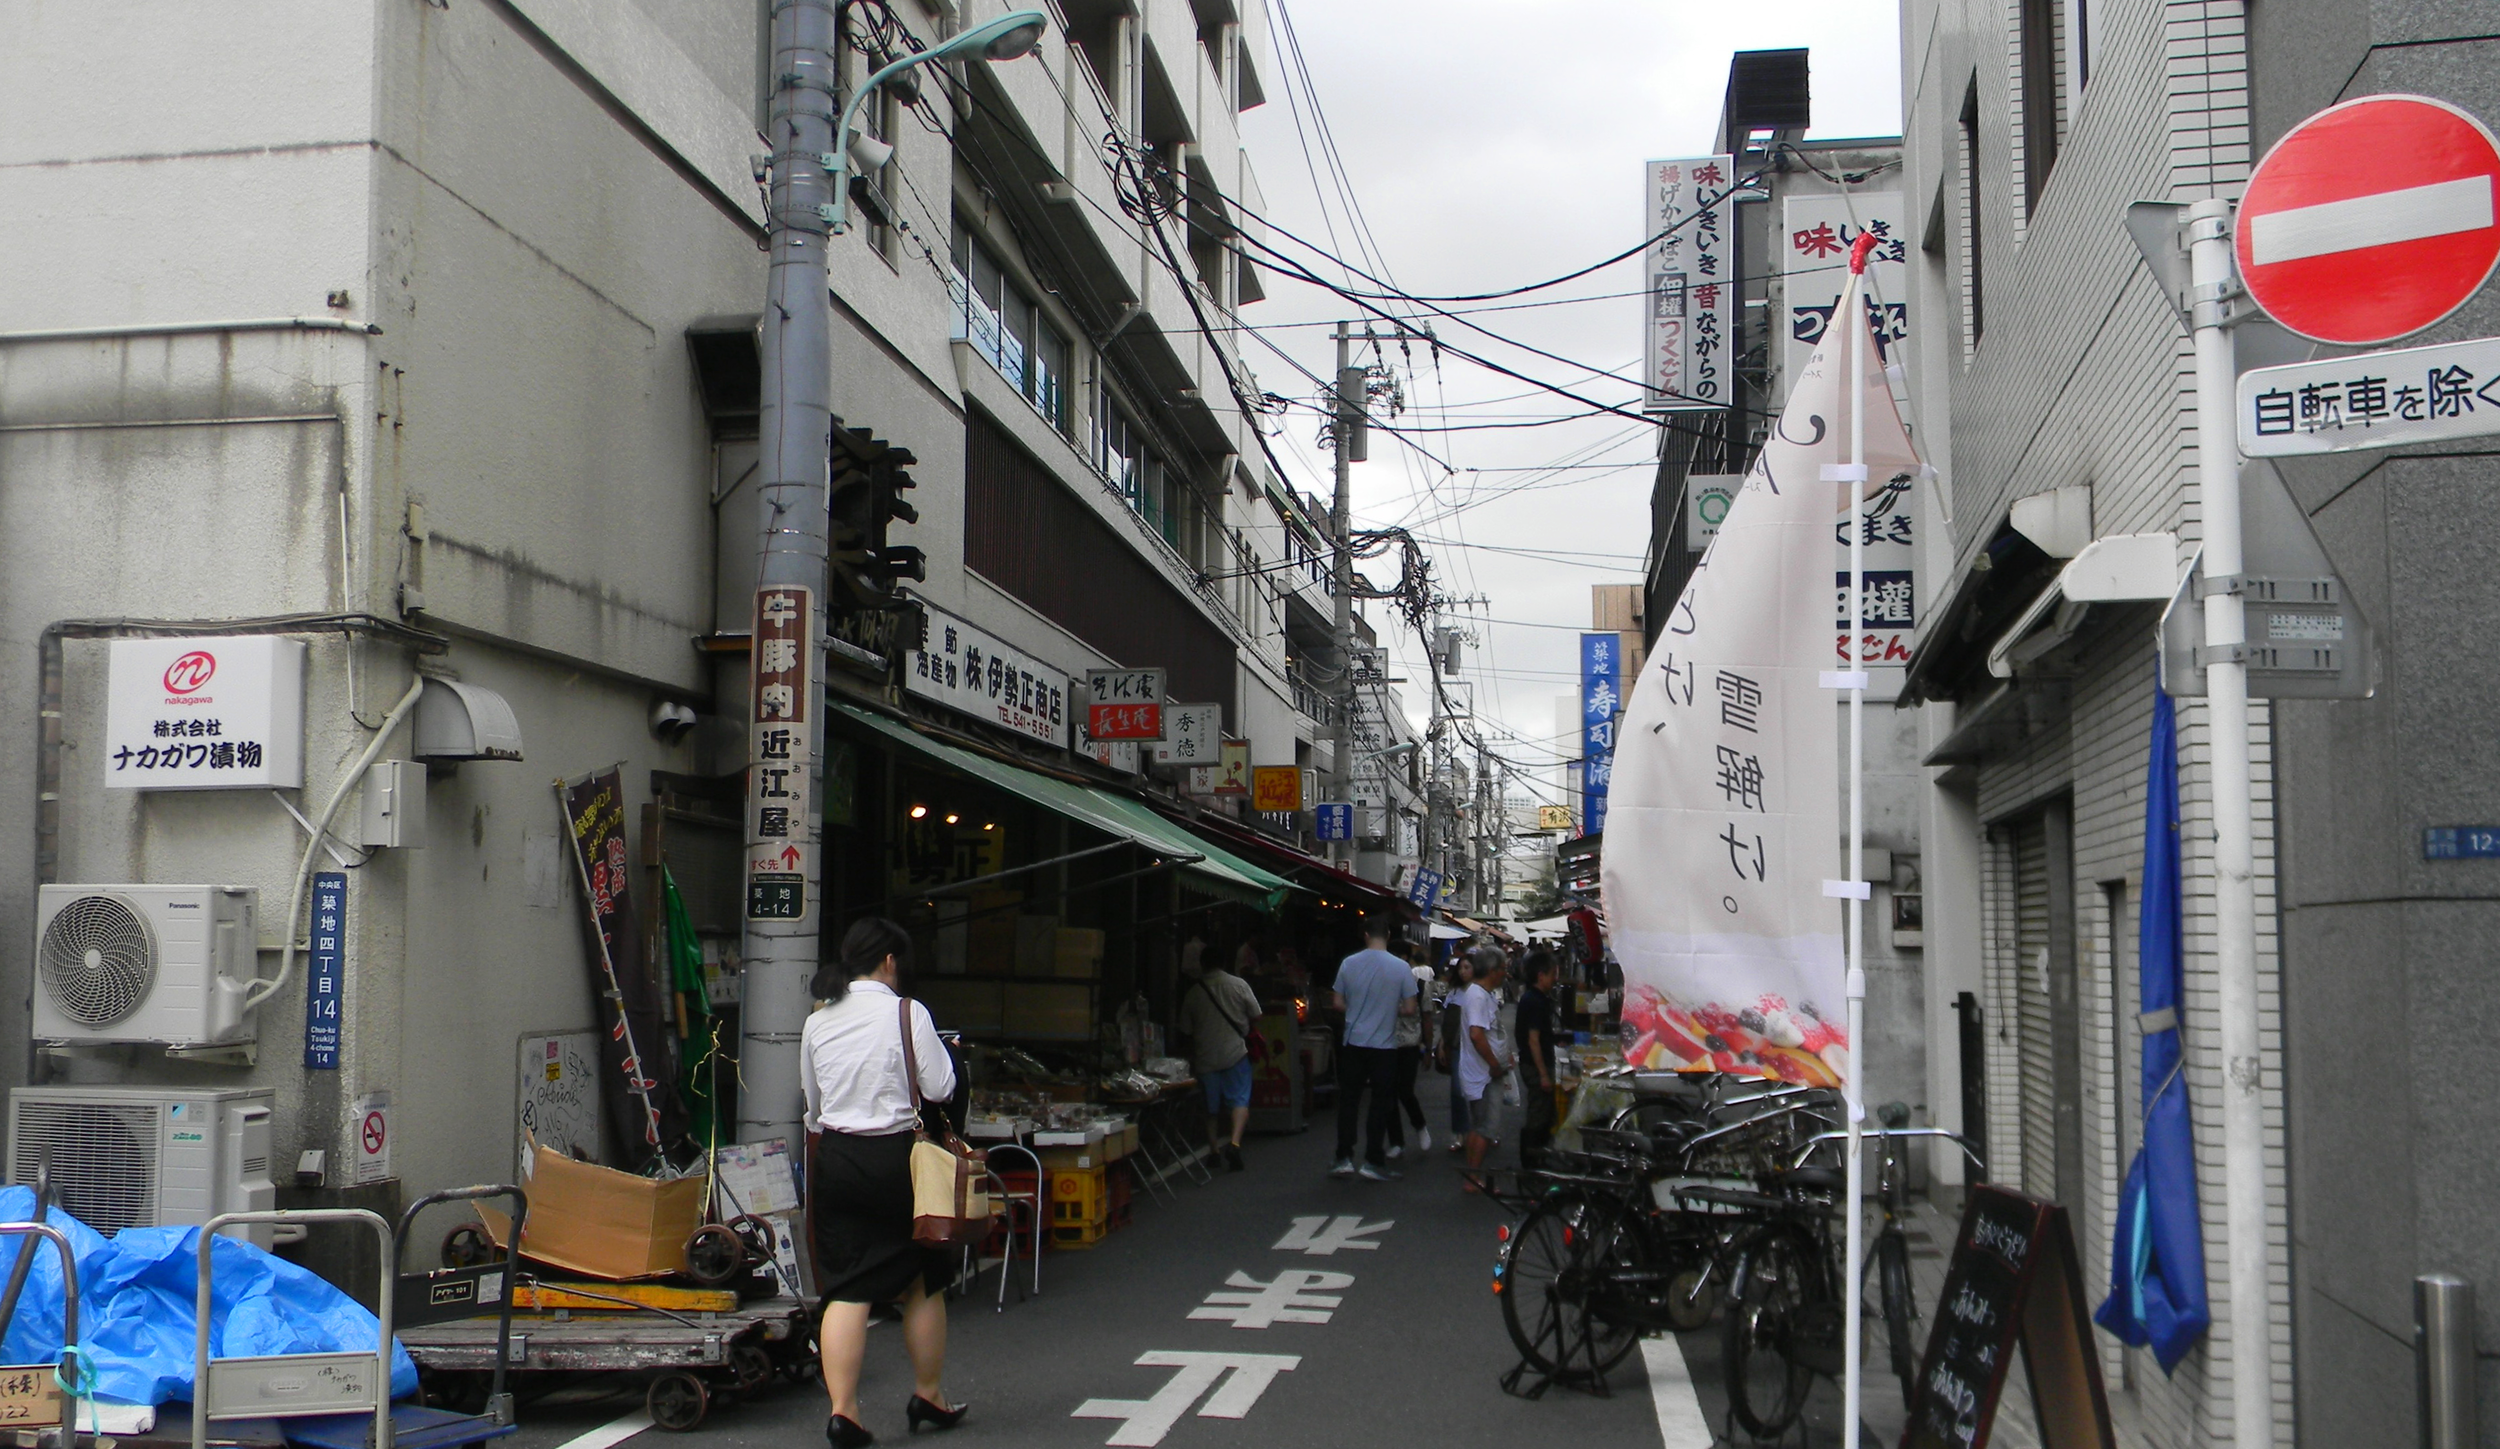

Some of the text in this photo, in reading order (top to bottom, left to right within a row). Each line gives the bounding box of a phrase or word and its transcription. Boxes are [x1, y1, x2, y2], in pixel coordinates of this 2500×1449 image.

[2256, 365, 2500, 436] 自転車を除く
[761, 594, 797, 719] 牛豚肉
[1593, 641, 1610, 675] 築地
[916, 650, 957, 689] 海産物
[165, 697, 213, 705] nakagawa
[154, 719, 222, 738] 株式会社
[998, 705, 1012, 724] TEL
[1013, 712, 1054, 740] 541-5551
[114, 741, 263, 771] ナカガワ漬物
[759, 730, 790, 837] 近江屋
[751, 859, 778, 870] すぐ先
[318, 881, 341, 889] 中央区
[755, 903, 789, 914] 4-14
[318, 895, 337, 993] 築地四丁目
[313, 1000, 336, 1019] 14
[311, 1026, 335, 1034] Chuo-ku
[311, 1035, 335, 1043] Tsukiji
[316, 1053, 328, 1063] 14
